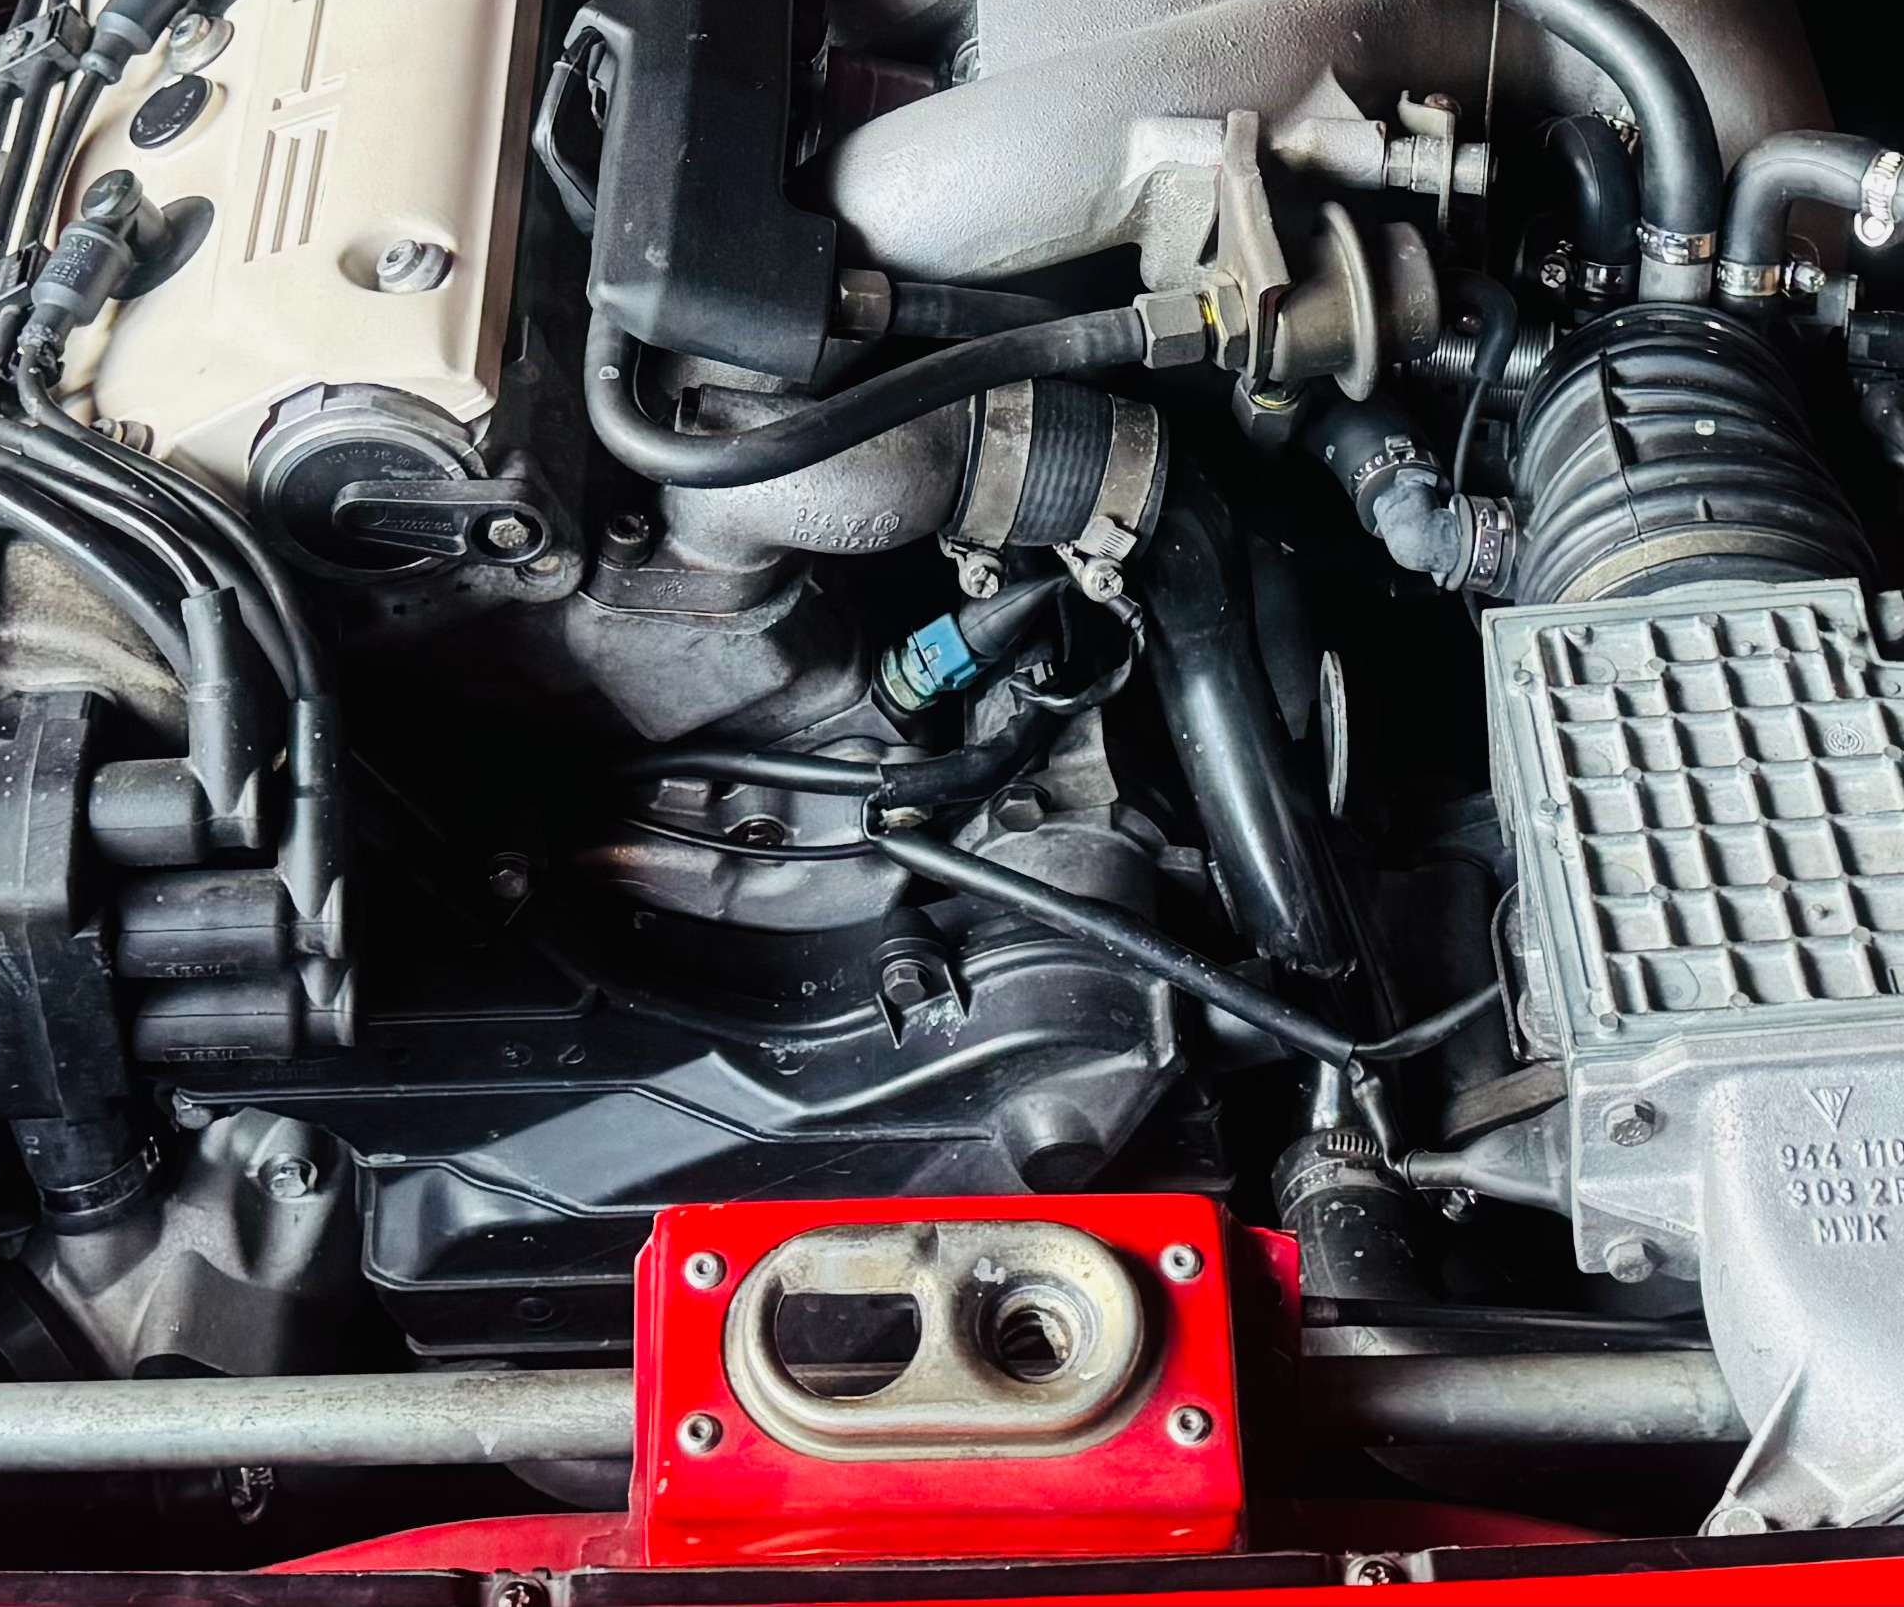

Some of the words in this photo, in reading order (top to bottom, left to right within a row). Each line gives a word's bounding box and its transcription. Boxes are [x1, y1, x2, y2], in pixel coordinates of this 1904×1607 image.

[1777, 1141, 1843, 1173] 944
[1783, 1177, 1857, 1209] 303
[1811, 1212, 1888, 1245] MWK
